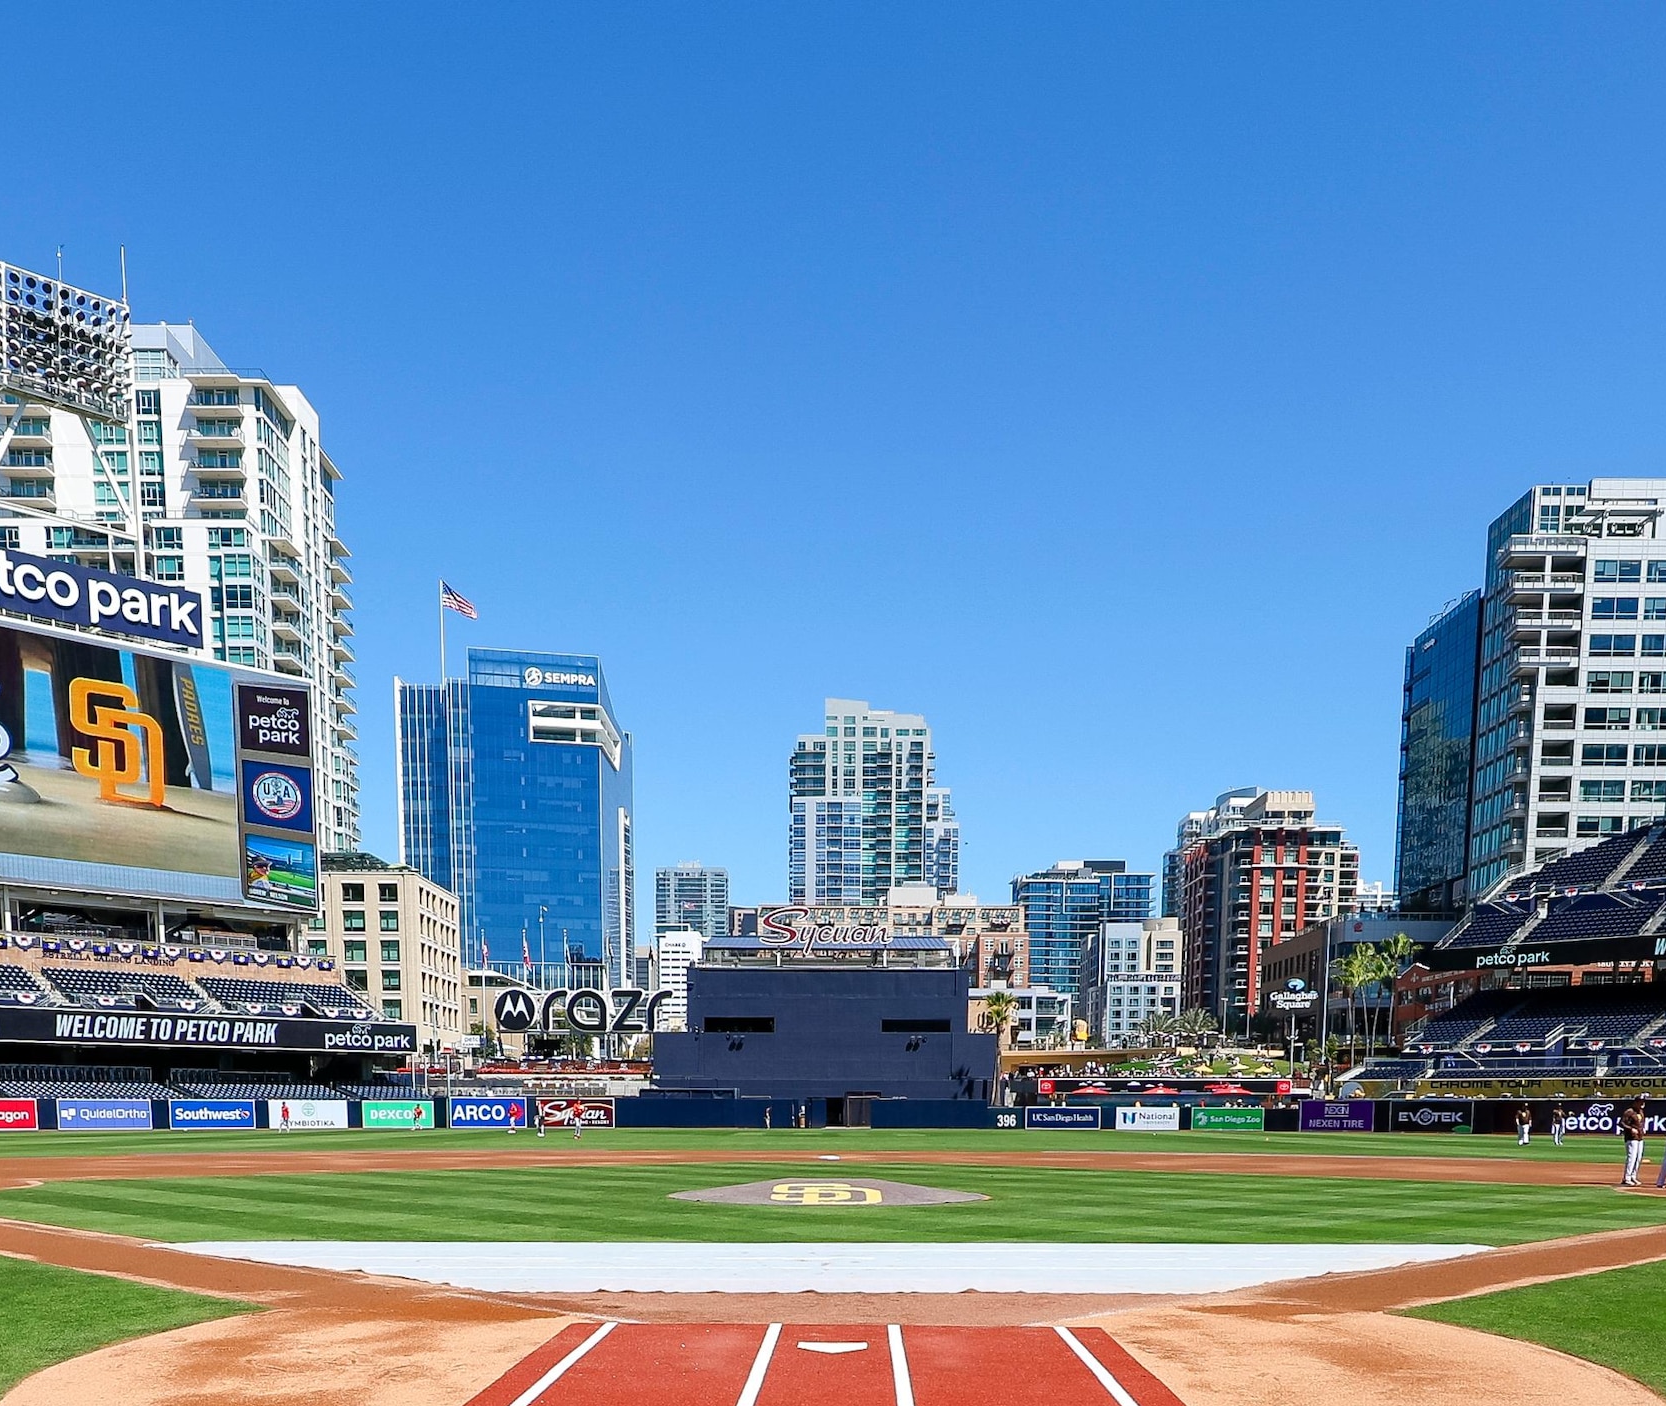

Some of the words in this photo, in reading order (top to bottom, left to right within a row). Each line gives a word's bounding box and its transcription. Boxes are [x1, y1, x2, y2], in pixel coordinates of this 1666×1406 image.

[87, 578, 200, 636] park
[544, 671, 596, 686] SEMPRA
[256, 694, 283, 705] Welcome
[180, 675, 205, 748] PADRES
[248, 714, 300, 732] petco
[259, 729, 301, 745] park
[760, 906, 893, 956] Sycuan
[42, 951, 92, 962] ESTRELLA
[94, 954, 133, 965] JALISCO
[135, 957, 175, 968] LANDING
[1476, 954, 1516, 968] petco
[1518, 950, 1550, 966] park
[1269, 991, 1320, 1003] Gallagher
[541, 987, 674, 1032] razr
[1276, 1000, 1311, 1011] Square
[55, 1014, 149, 1041] WELCOME
[150, 1018, 172, 1041] TO
[175, 1019, 229, 1042] PETCO
[232, 1021, 279, 1044] PARK
[325, 1030, 372, 1048] petco
[374, 1032, 410, 1050] park
[1430, 1079, 1493, 1089] CHROME
[1496, 1079, 1542, 1089] TOUR
[1562, 1078, 1590, 1088] THE
[80, 1107, 148, 1120] QuidelOrtho
[175, 1107, 241, 1121] Southwest
[453, 1104, 505, 1121] ARCO
[1032, 1113, 1043, 1122] UC
[1043, 1113, 1056, 1122] San
[1056, 1113, 1073, 1124] Diego
[1073, 1113, 1094, 1122] Health
[1138, 1112, 1175, 1121] National
[1210, 1115, 1224, 1124] San
[1224, 1115, 1246, 1125] Diego
[1246, 1115, 1261, 1124] Zoo
[1398, 1108, 1464, 1126] EVOTEK
[996, 1114, 1017, 1128] 396
[1308, 1119, 1341, 1129] NEXEN
[1343, 1119, 1364, 1129] TIRE
[1563, 1111, 1613, 1131] etco
